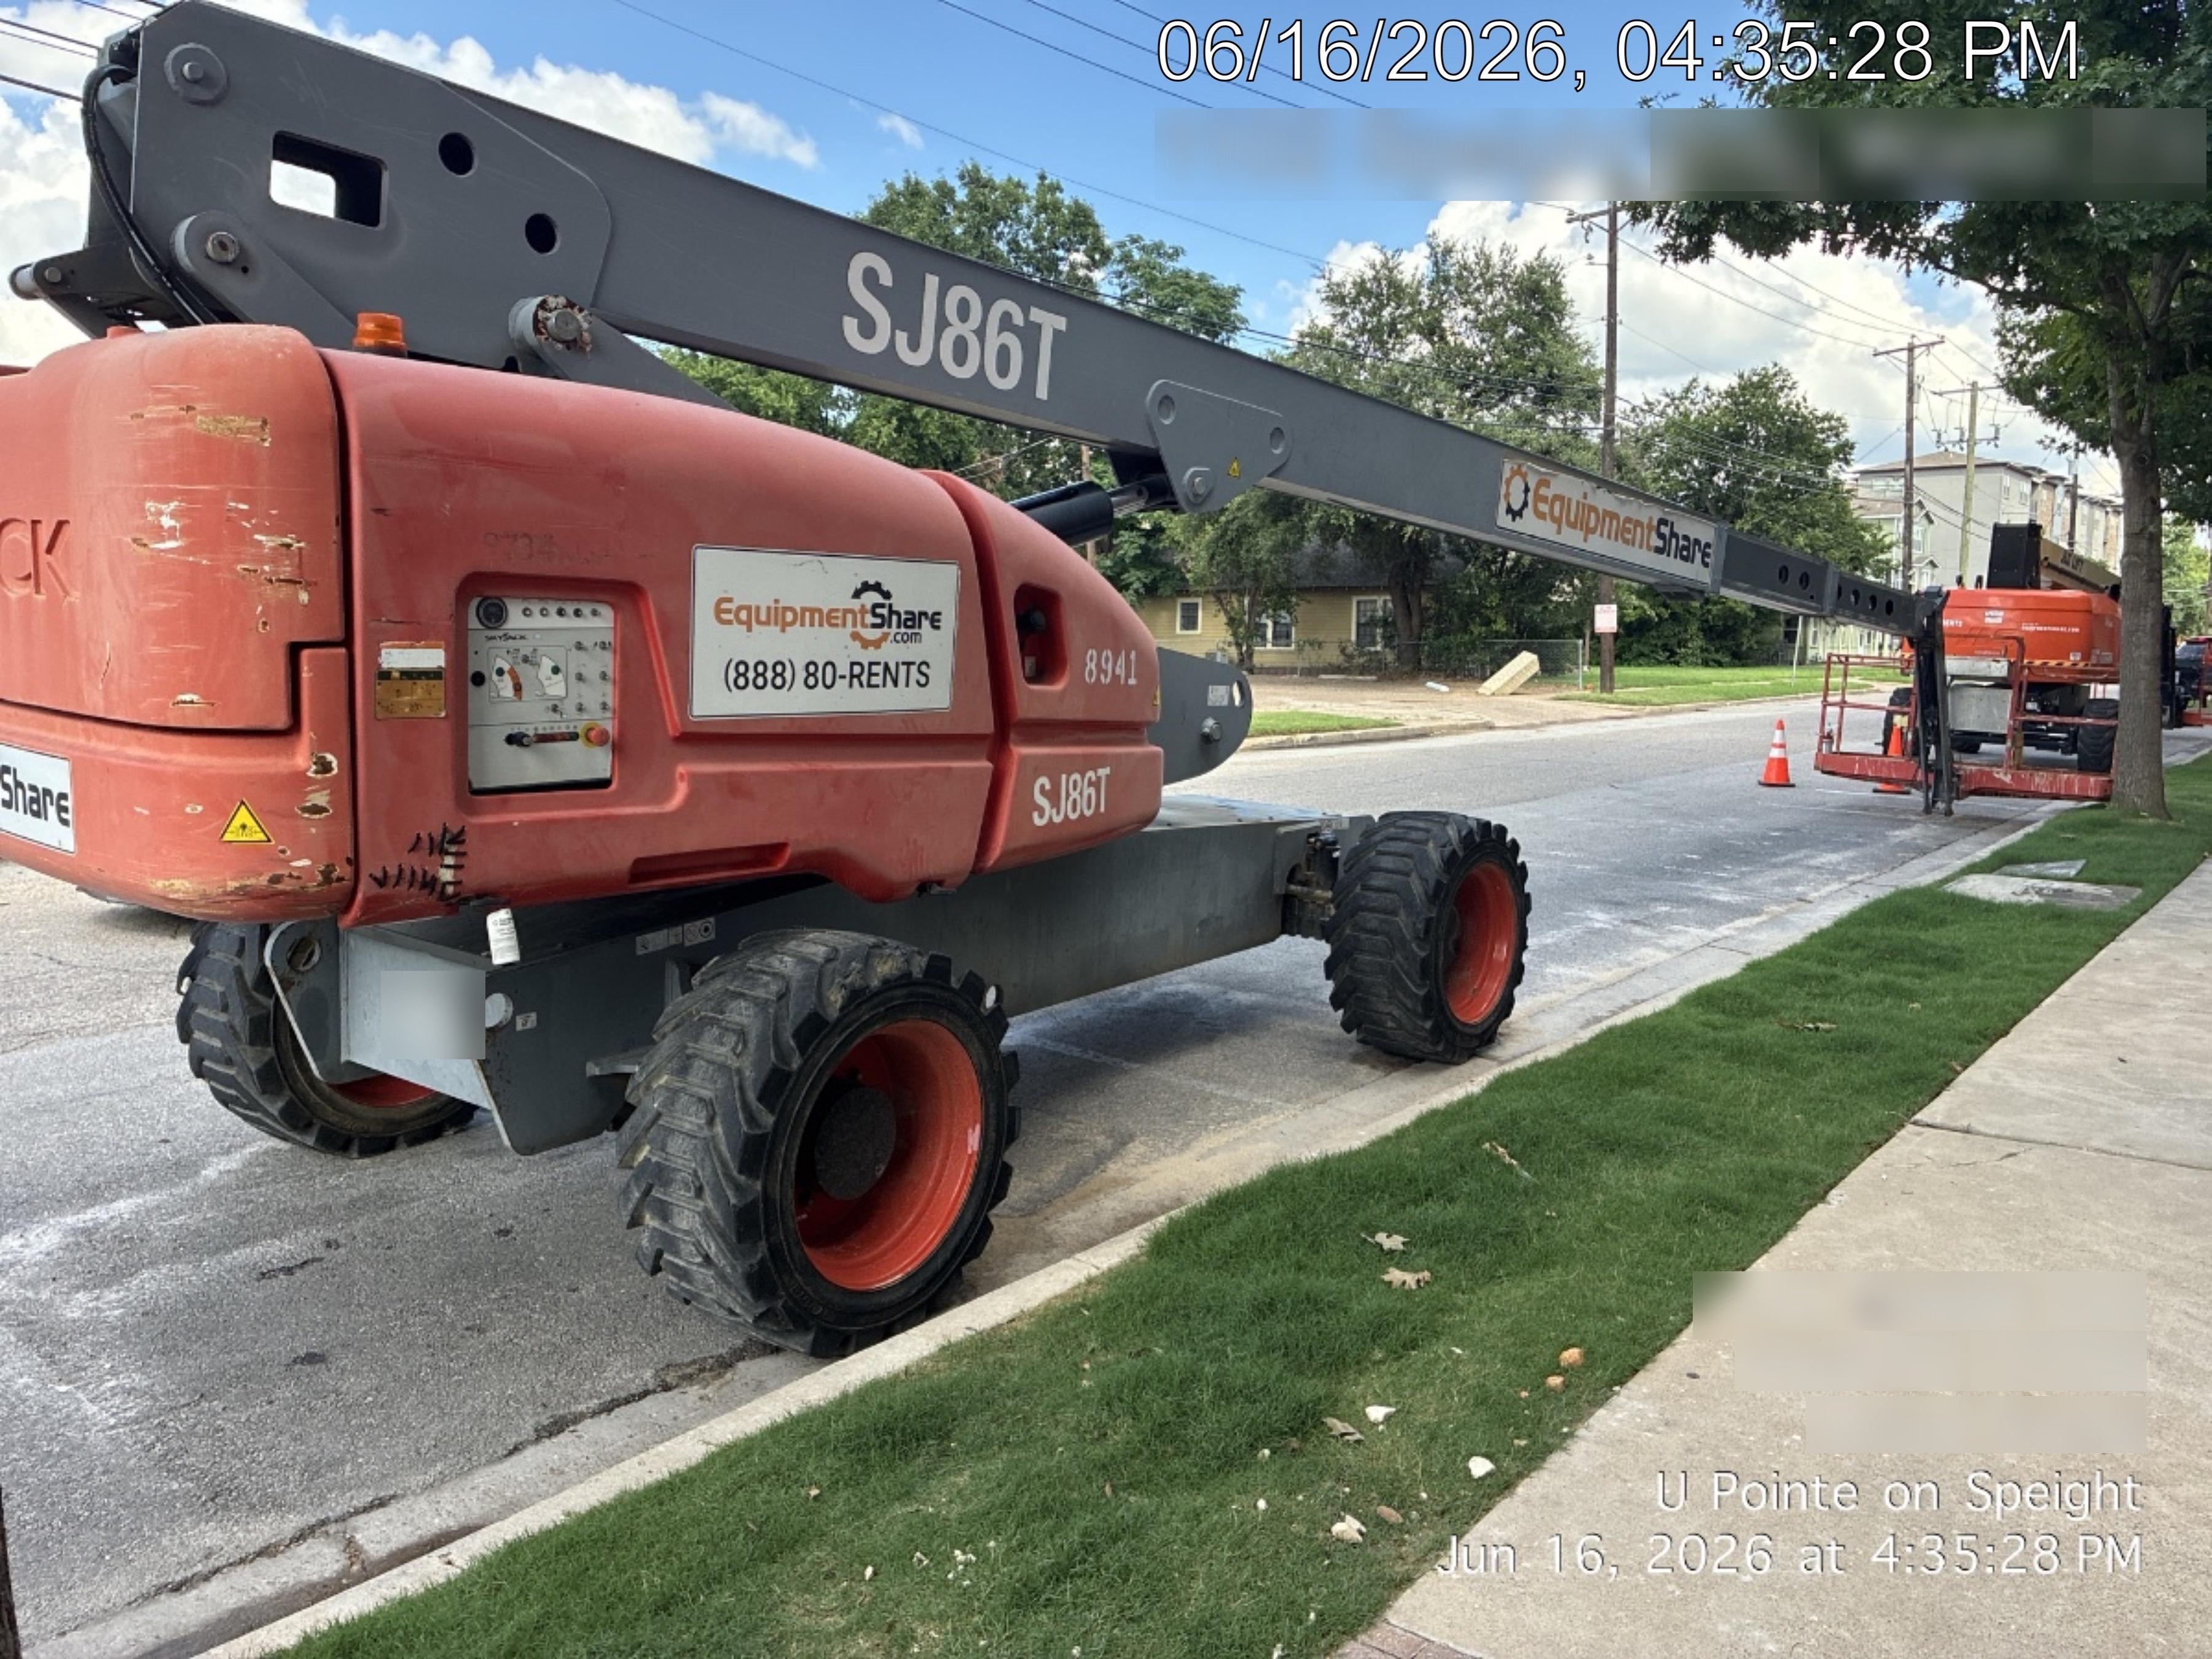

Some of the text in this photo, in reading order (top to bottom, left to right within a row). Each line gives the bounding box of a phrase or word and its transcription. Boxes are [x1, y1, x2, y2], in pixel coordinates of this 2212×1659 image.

[842, 252, 1067, 401] SJ86T
[1532, 478, 1711, 568] EquipmentShare
[0, 517, 74, 598] CK
[713, 597, 943, 632] EquipmentShare
[890, 630, 922, 644] .com
[724, 658, 931, 692] (888) 80-RENTS
[1084, 648, 1138, 686] 8941
[0, 764, 71, 828] Share
[1032, 766, 1110, 827] SJ86T
